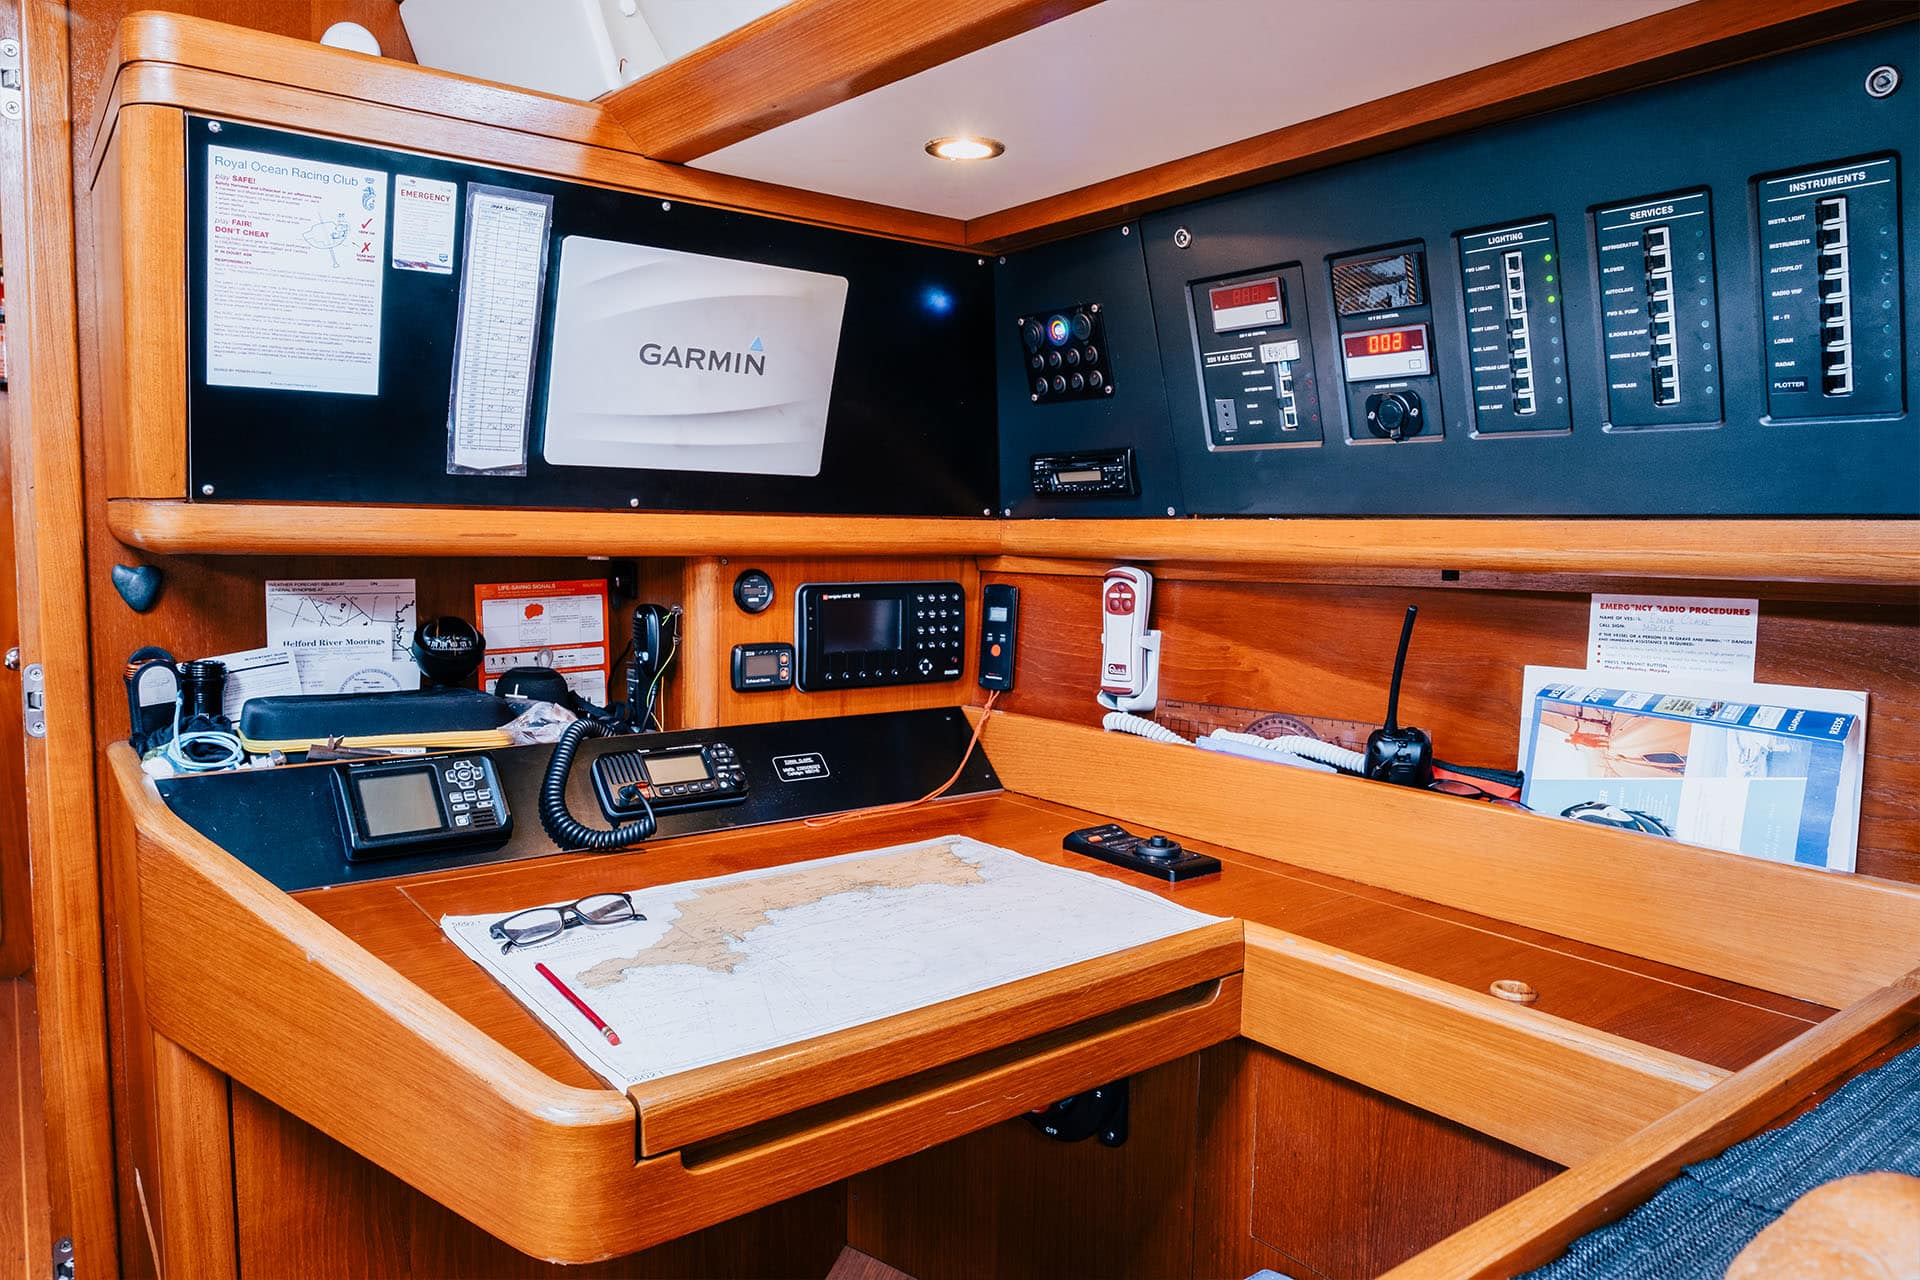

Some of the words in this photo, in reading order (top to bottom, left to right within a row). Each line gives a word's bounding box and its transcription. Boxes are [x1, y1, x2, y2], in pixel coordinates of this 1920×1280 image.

[215, 156, 248, 170] Royal
[251, 162, 288, 176] Ocean
[292, 168, 330, 185] Racing
[333, 174, 358, 186] Club
[232, 174, 256, 184] SAFE!
[1789, 171, 1866, 193] INSTRUMENTS
[400, 188, 450, 202] EMERGENCY
[1630, 205, 1674, 220] SERVICES
[232, 219, 252, 227] FAIR!
[1788, 214, 1805, 222] LIGHT
[215, 226, 240, 234] DON'T
[243, 229, 269, 238] CHEAT
[1488, 232, 1524, 245] LIGHTING
[1602, 241, 1639, 251] REFRIGERATOR
[1769, 239, 1810, 249] INSTRUMENTS
[1771, 264, 1803, 273] AUTOPILOT
[1605, 286, 1634, 295] AUTOCLAVE
[639, 343, 765, 376] GARMIN
[1230, 352, 1252, 361] SECTION
[1774, 381, 1804, 389] PLOTTER
[1689, 606, 1751, 616] PROCEDURES
[345, 638, 385, 647] Moorings
[1829, 717, 1846, 735] REEDS
